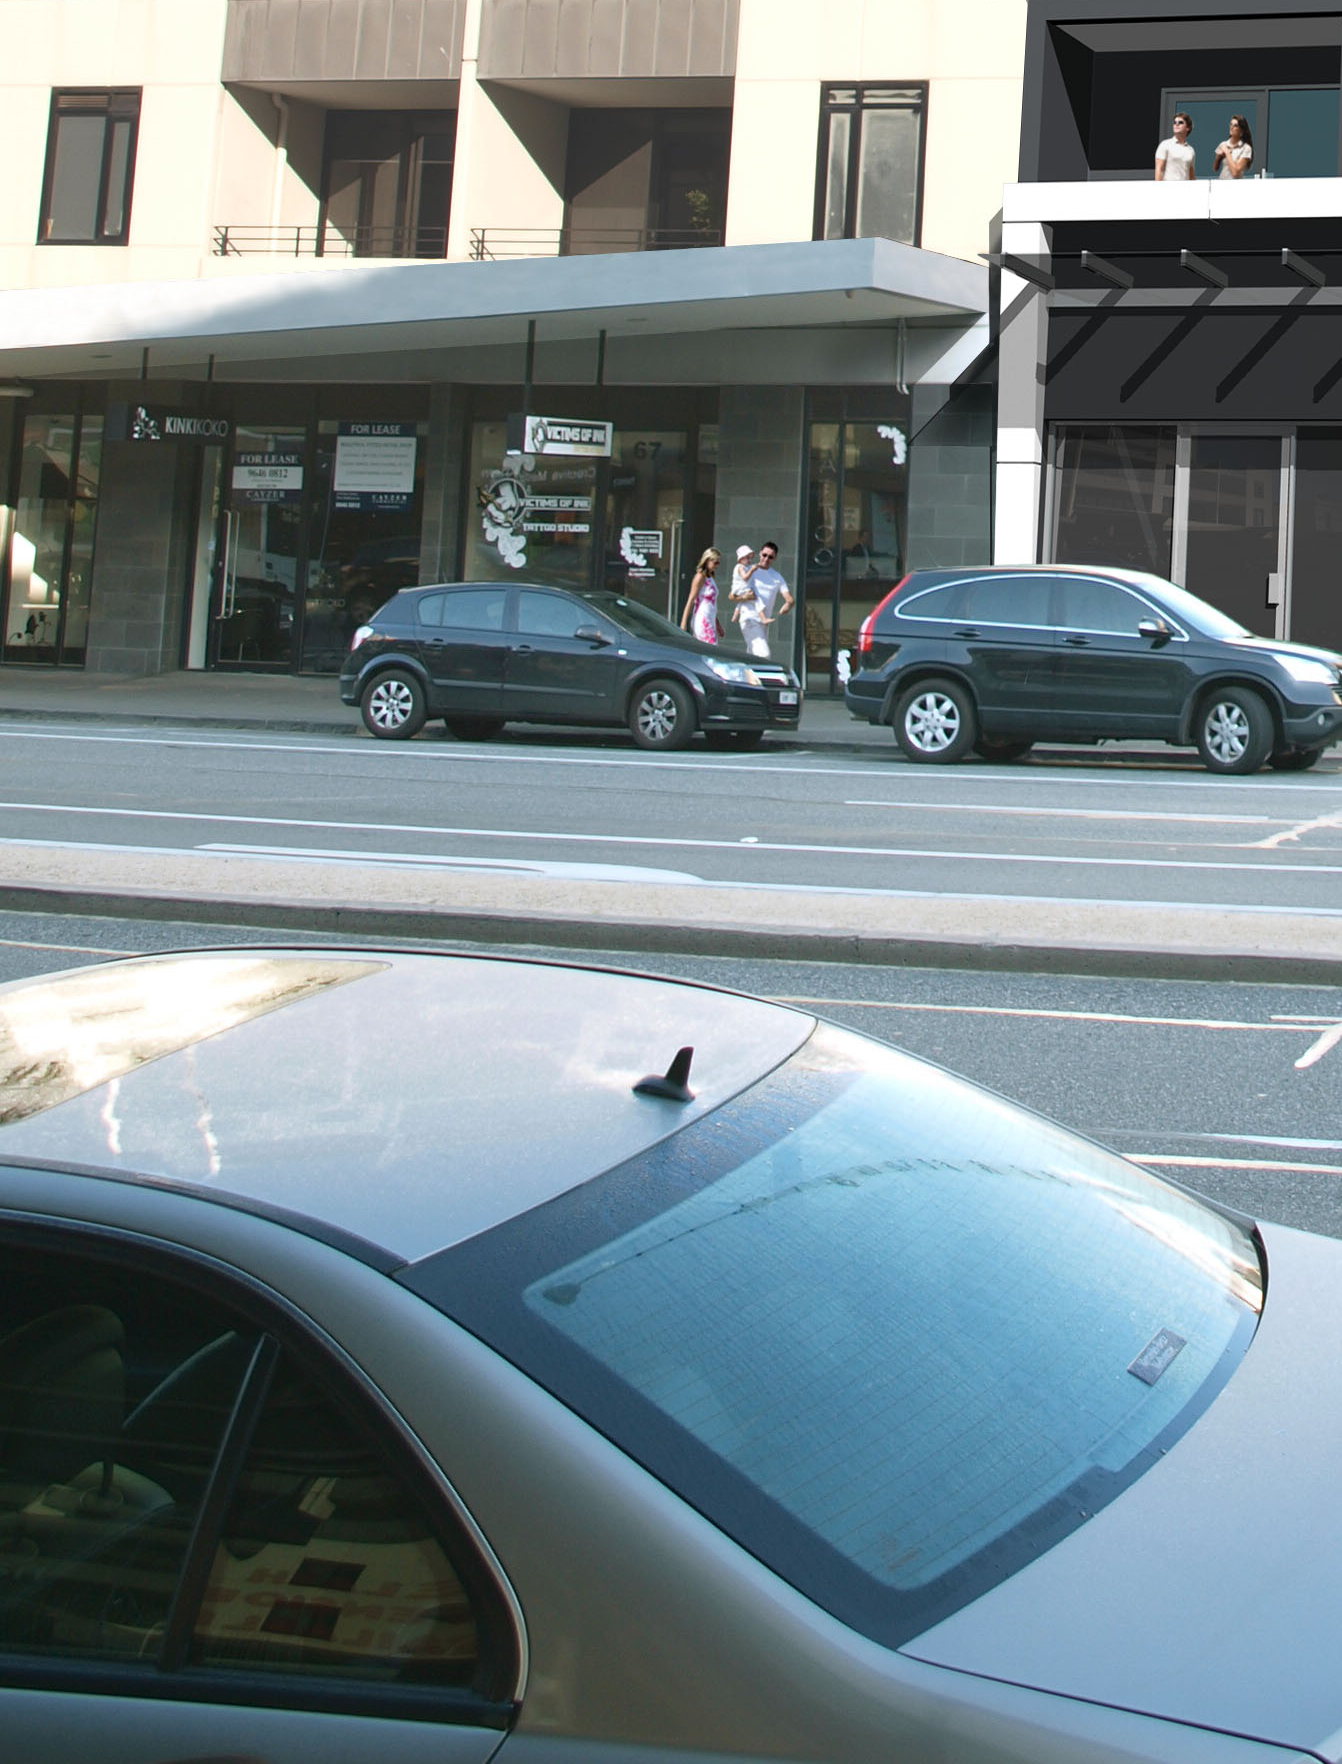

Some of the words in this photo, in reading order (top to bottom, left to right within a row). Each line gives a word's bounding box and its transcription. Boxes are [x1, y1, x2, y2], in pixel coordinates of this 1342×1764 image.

[165, 416, 229, 437] KINKIKOKO
[351, 424, 370, 435] FOR
[371, 424, 401, 435] LEASE
[546, 425, 580, 442] VICTIMS
[580, 427, 592, 442] OF
[592, 428, 606, 443] INK
[634, 441, 662, 459] 67
[240, 454, 262, 465] FOR
[263, 454, 299, 465] LEASE
[519, 498, 558, 508] VICTIMS
[559, 499, 573, 508] OF
[523, 523, 557, 532] TATTOO
[557, 523, 590, 533] STUDIO
